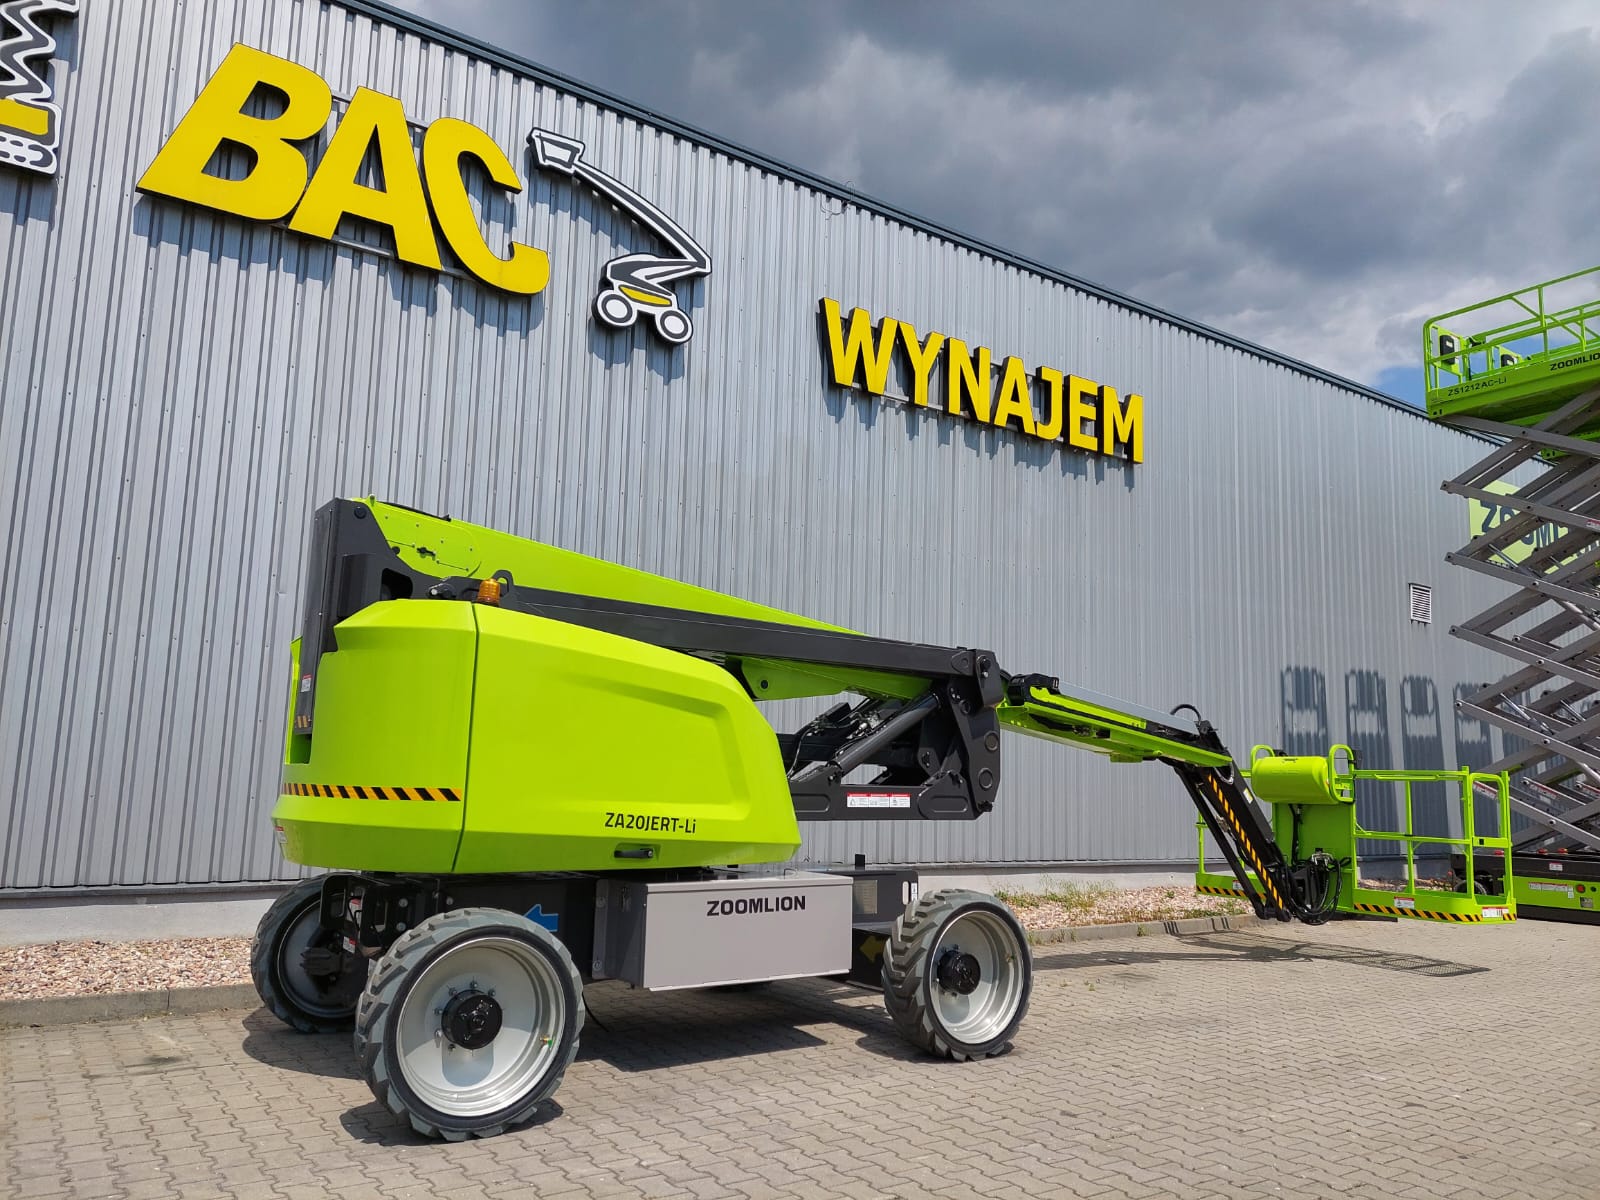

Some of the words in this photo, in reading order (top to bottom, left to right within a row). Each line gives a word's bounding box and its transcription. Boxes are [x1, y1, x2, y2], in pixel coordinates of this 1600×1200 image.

[137, 42, 550, 295] BAC
[821, 296, 1144, 465] WYNAJEM
[604, 812, 697, 834] ZA20JERT-Li
[706, 895, 806, 916] ZOOMLION
